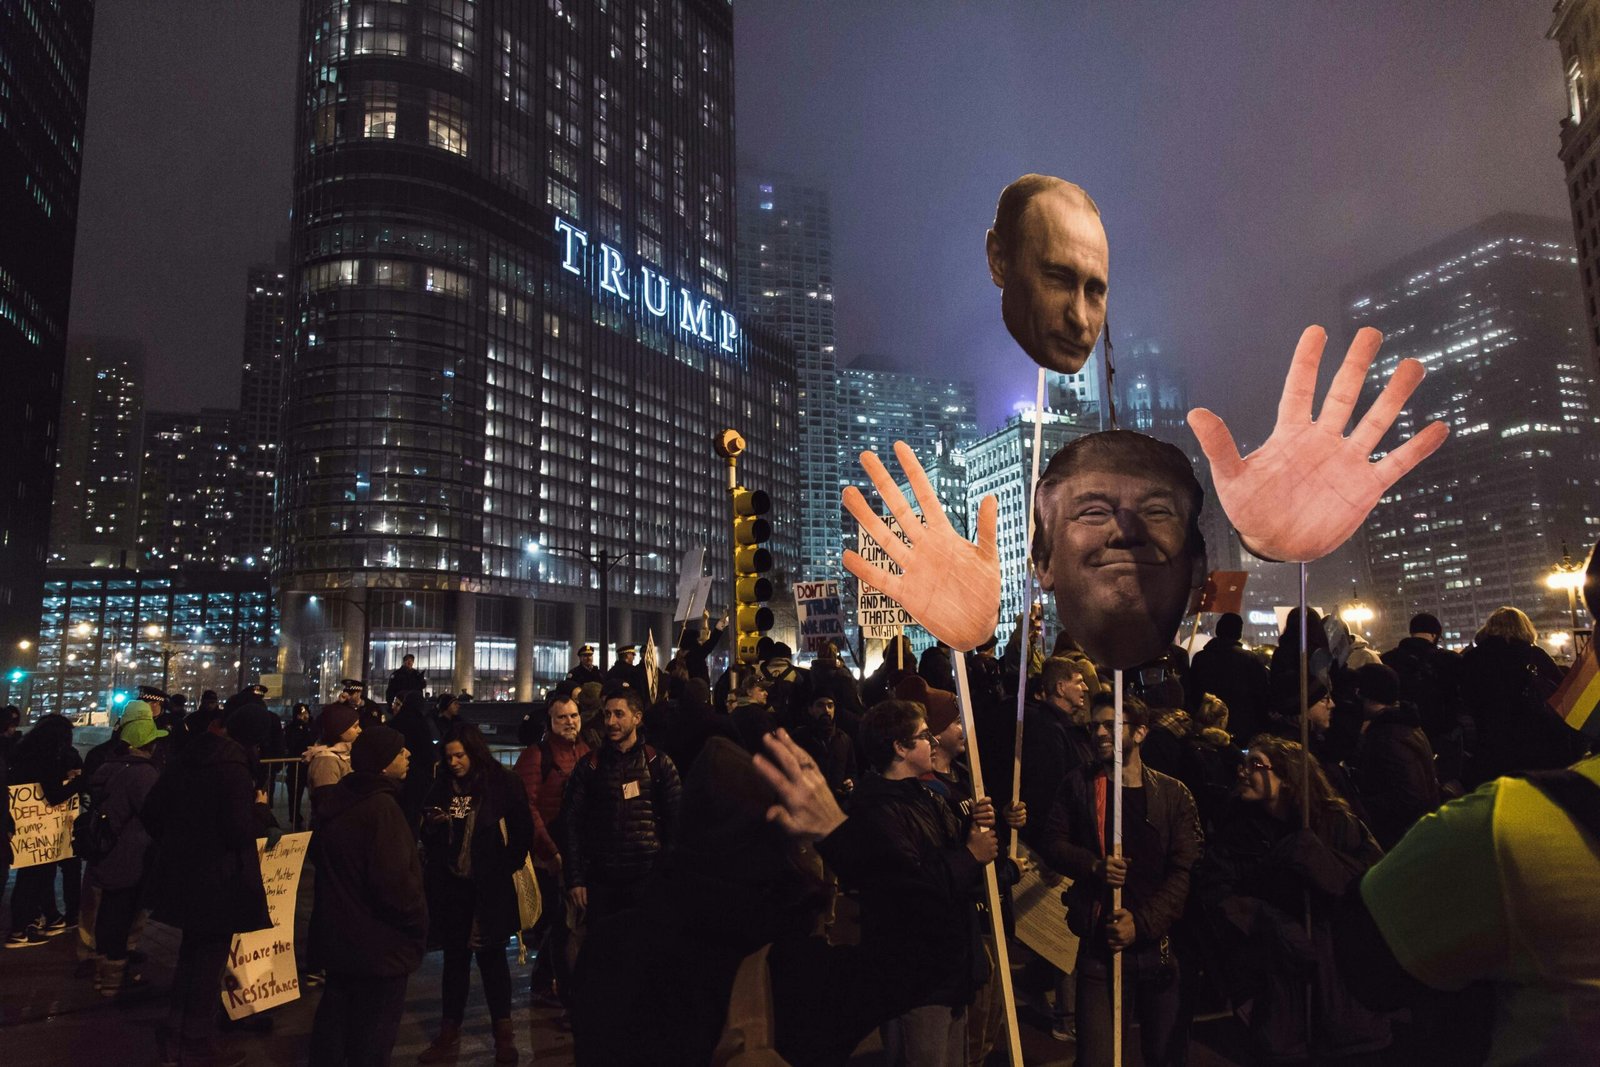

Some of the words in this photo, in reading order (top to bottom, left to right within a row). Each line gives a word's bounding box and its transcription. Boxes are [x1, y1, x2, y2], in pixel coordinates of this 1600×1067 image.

[555, 216, 738, 352] TRUMP
[860, 596, 878, 609] AND
[9, 786, 45, 810] YOU
[10, 835, 52, 854] VAGINA
[230, 939, 251, 969] You
[253, 947, 270, 960] are
[272, 940, 291, 955] the
[225, 972, 298, 1009] Resistance
